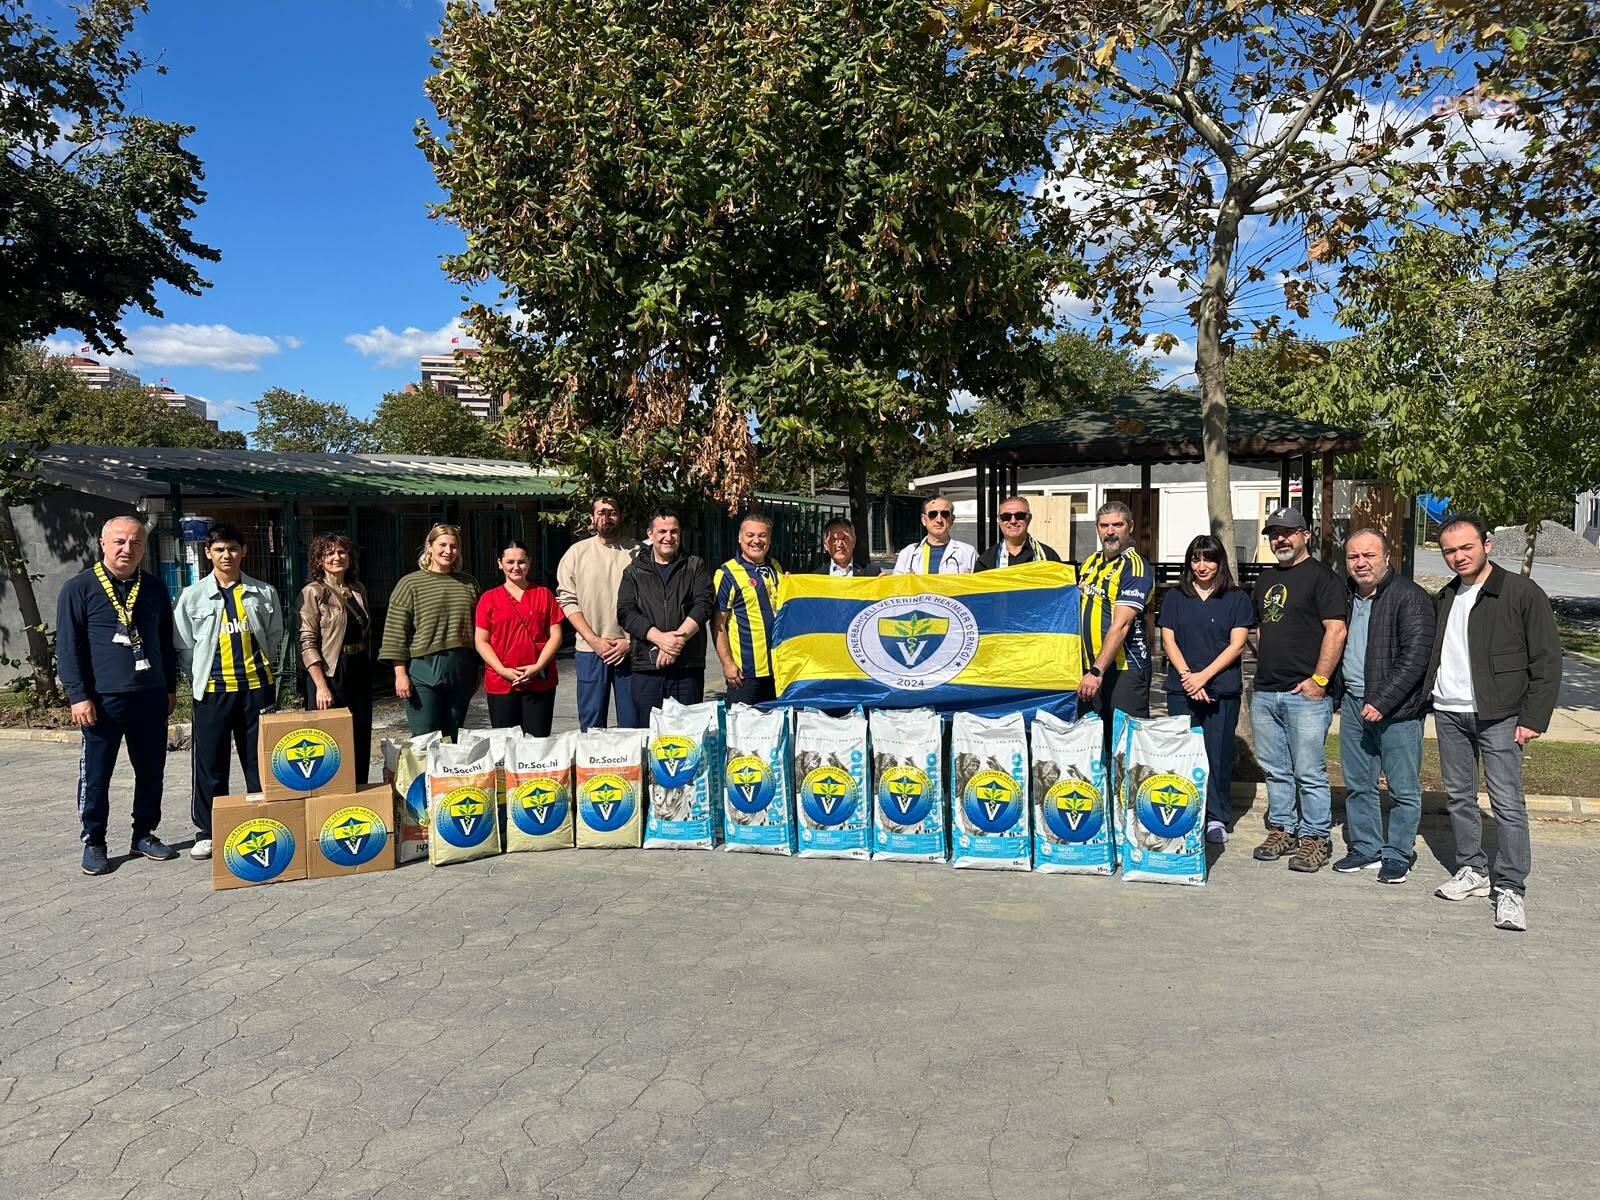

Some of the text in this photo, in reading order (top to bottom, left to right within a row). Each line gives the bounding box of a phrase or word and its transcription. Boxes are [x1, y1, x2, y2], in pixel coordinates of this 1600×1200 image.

[896, 678, 925, 688] 2024
[589, 755, 628, 764] Dr.Sacchi
[443, 763, 482, 774] Dr.Sacchi
